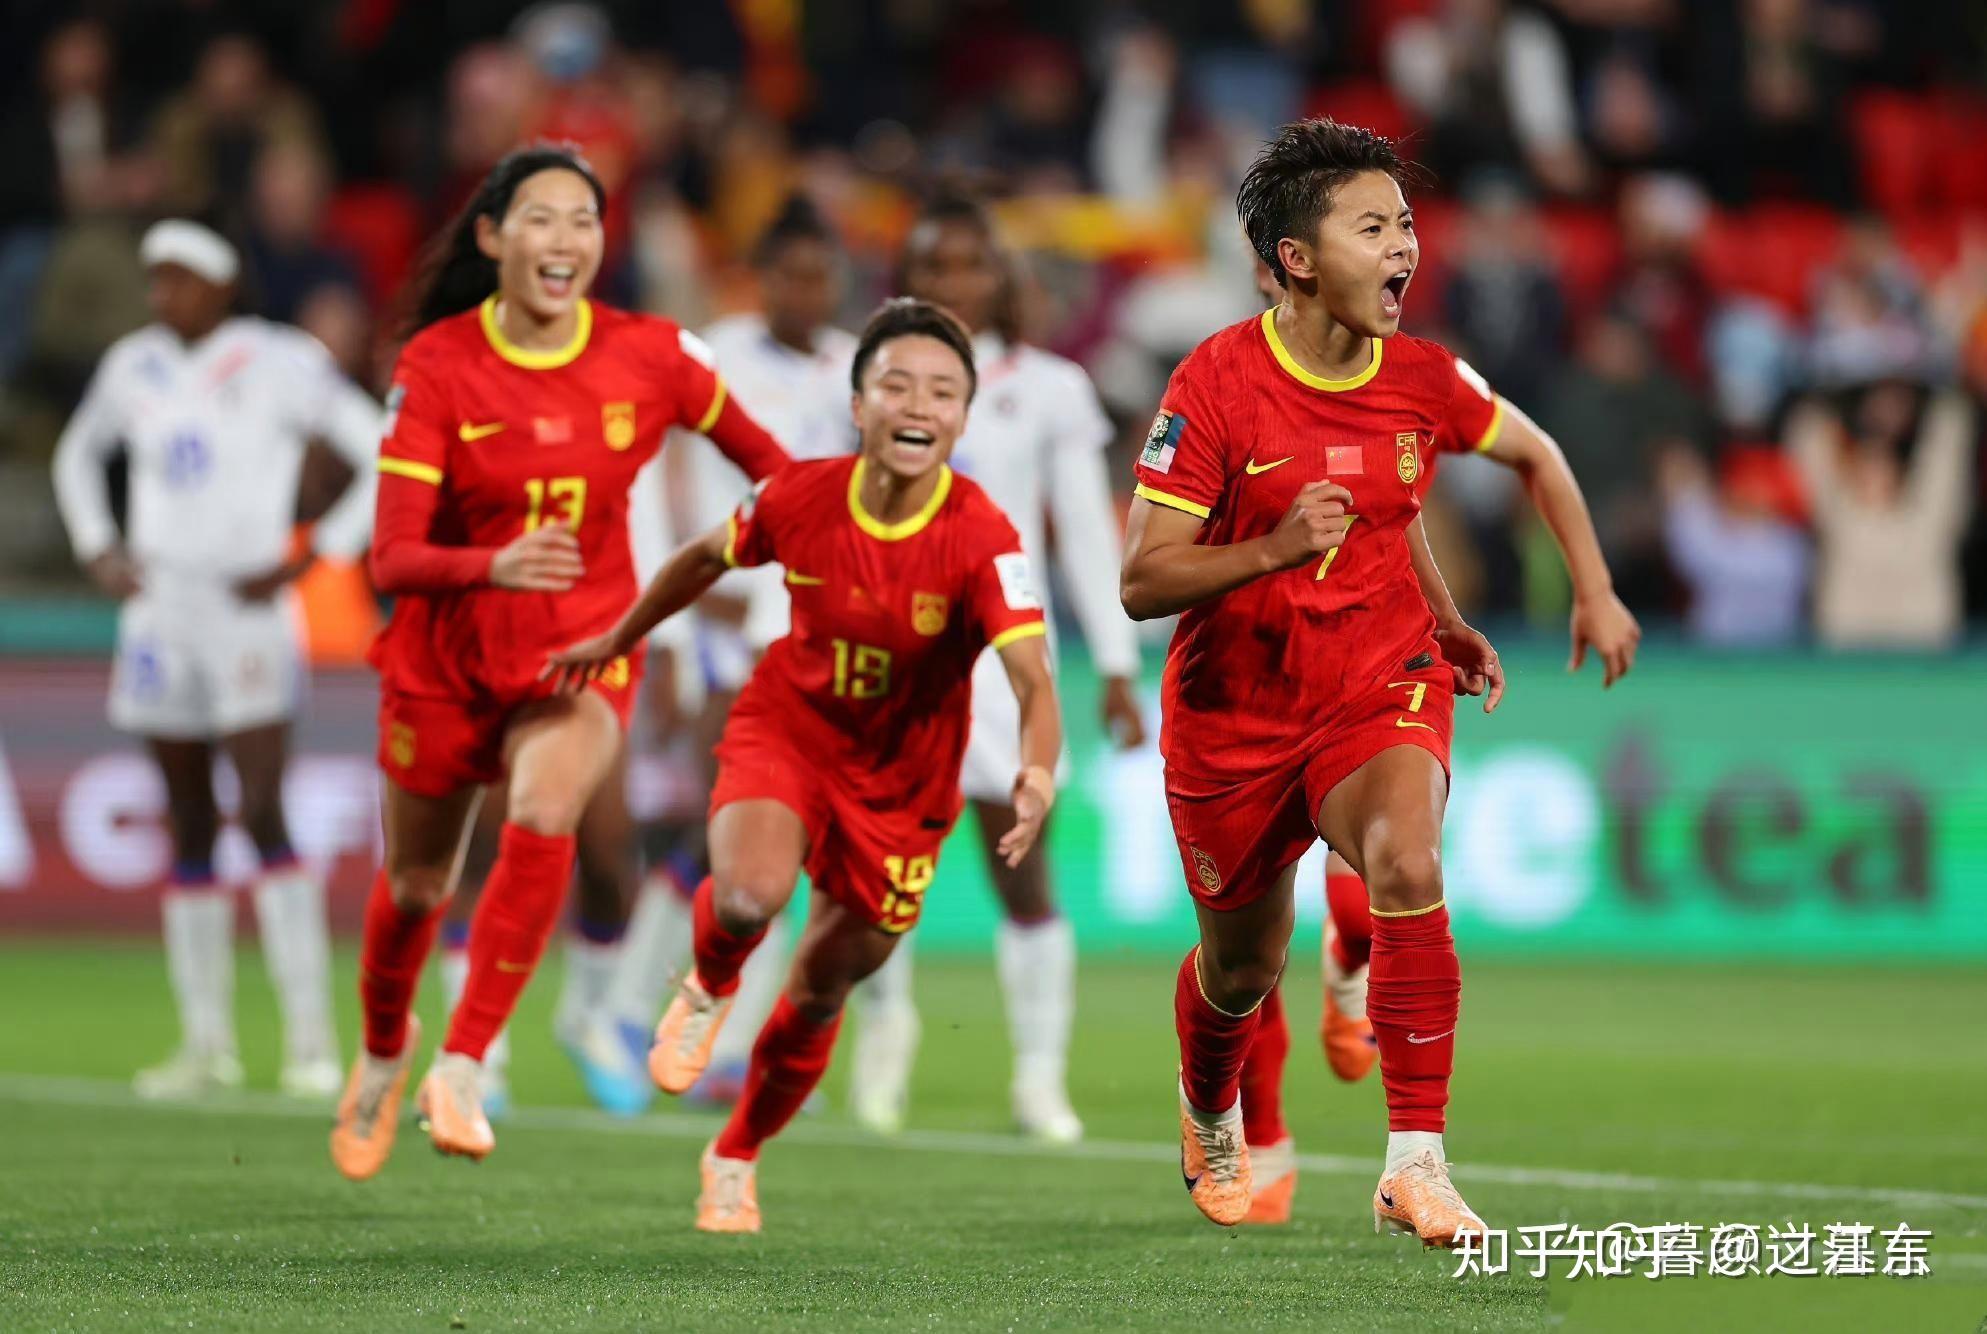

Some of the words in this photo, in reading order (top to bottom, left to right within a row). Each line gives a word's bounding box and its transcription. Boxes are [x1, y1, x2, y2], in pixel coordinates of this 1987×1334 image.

[524, 475, 588, 536] 13
[832, 638, 891, 699] 19
[1387, 681, 1427, 713] 7
